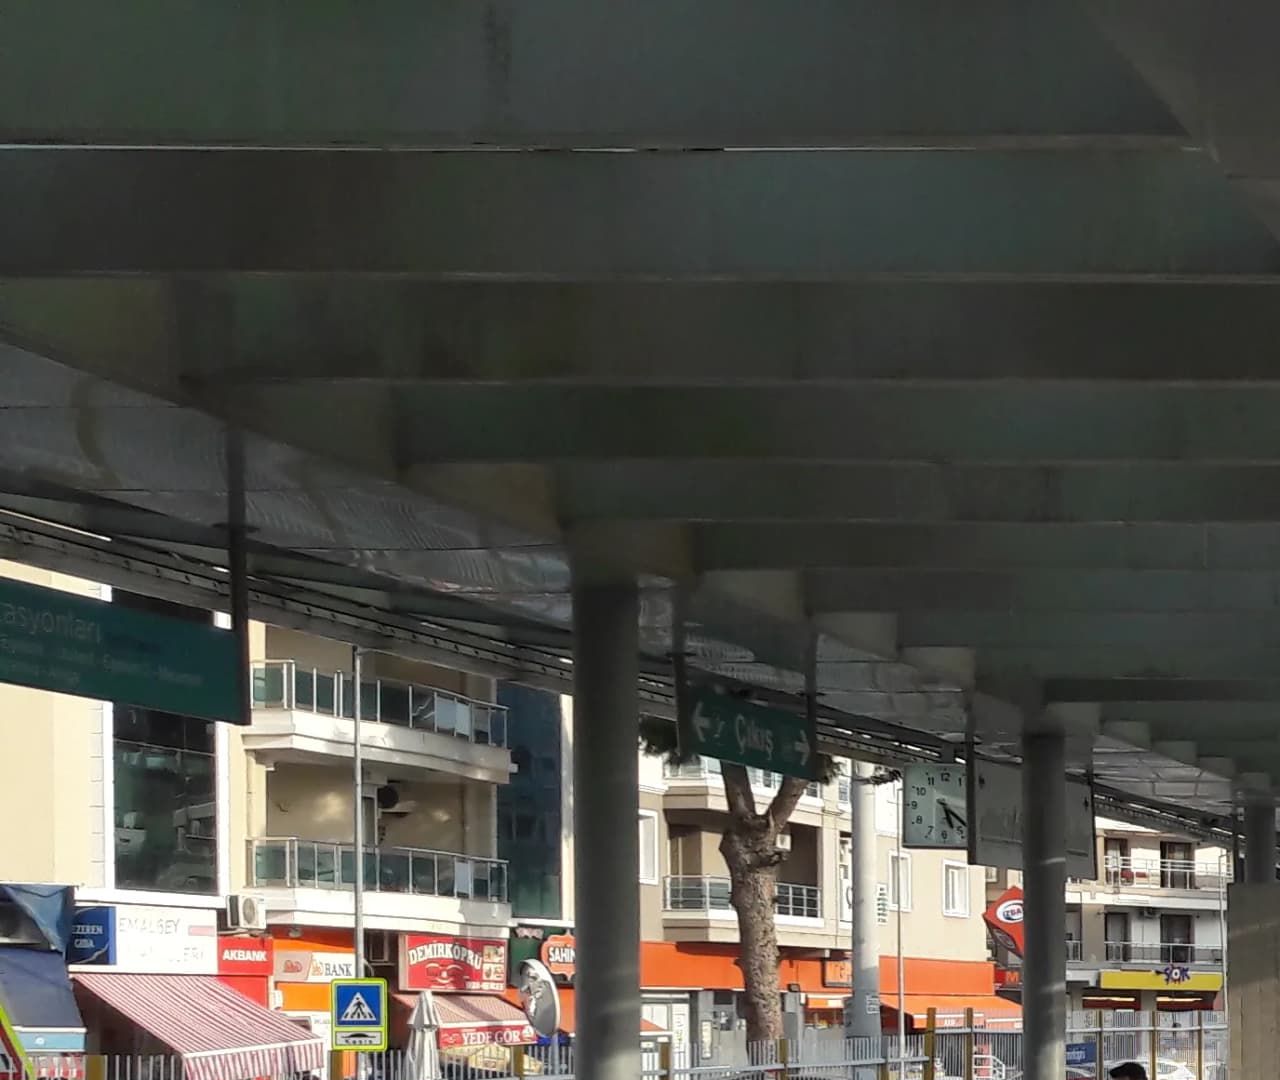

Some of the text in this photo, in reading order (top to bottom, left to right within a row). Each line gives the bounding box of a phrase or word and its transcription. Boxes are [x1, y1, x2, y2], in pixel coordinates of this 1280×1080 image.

[223, 949, 267, 962] AKBANK
[408, 940, 482, 970] DEMİRKÖPRÜ
[324, 962, 353, 977] BANK
[495, 1028, 521, 1042] GÖR
